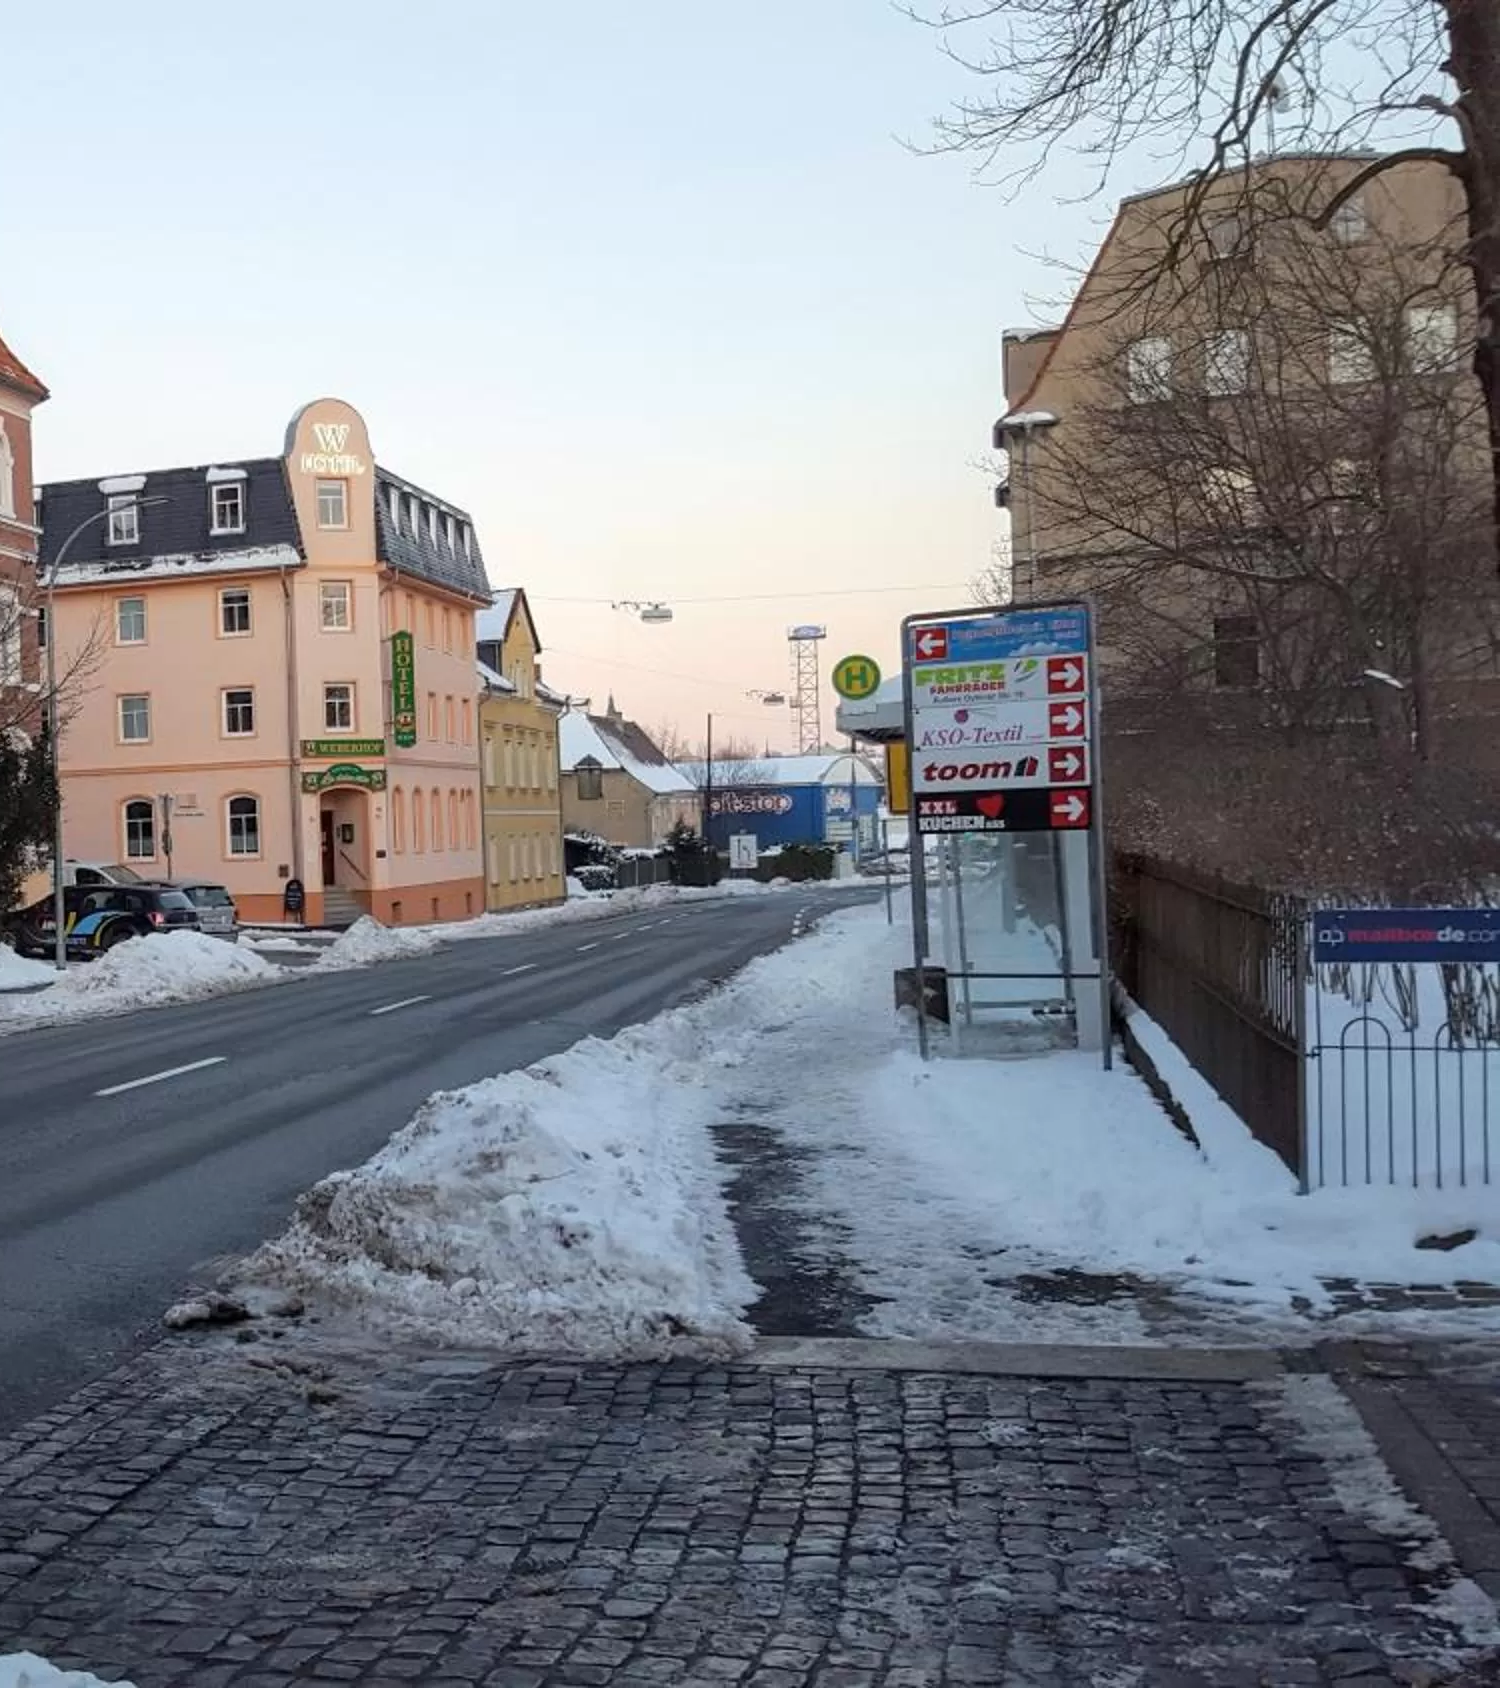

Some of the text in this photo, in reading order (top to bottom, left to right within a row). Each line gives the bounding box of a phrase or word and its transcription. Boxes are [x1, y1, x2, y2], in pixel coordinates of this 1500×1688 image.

[313, 423, 350, 453] W
[395, 639, 411, 711] HOTEL
[845, 666, 868, 690] H
[915, 664, 1005, 687] FRITZ
[921, 725, 1024, 748] KSO-Textil
[922, 761, 1012, 782] toom
[919, 800, 958, 815] XXL
